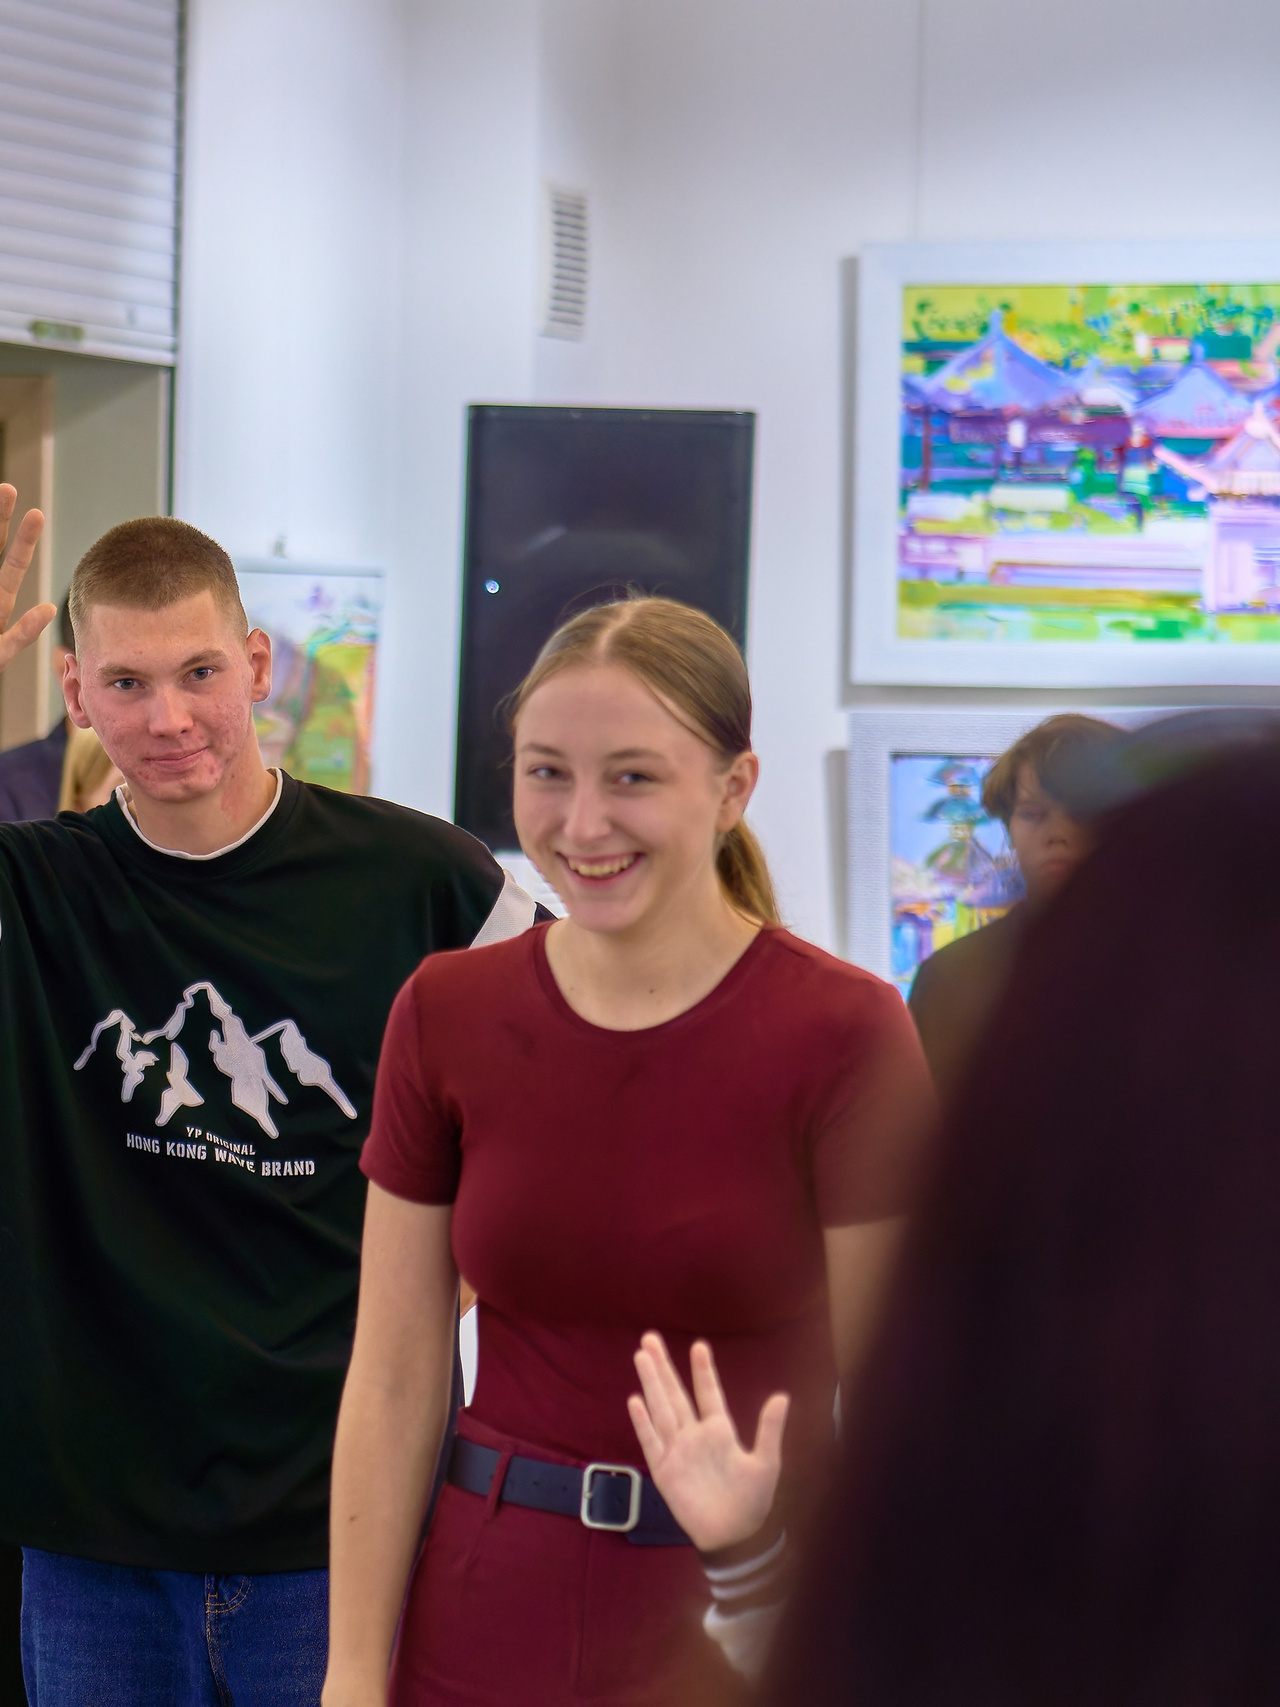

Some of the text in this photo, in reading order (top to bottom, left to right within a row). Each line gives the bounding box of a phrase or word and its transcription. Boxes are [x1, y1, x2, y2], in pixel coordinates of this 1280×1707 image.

[126, 1133, 316, 1177] HONG KONG WAVE BRAND
[185, 1127, 256, 1155] YP ORIGINAL
